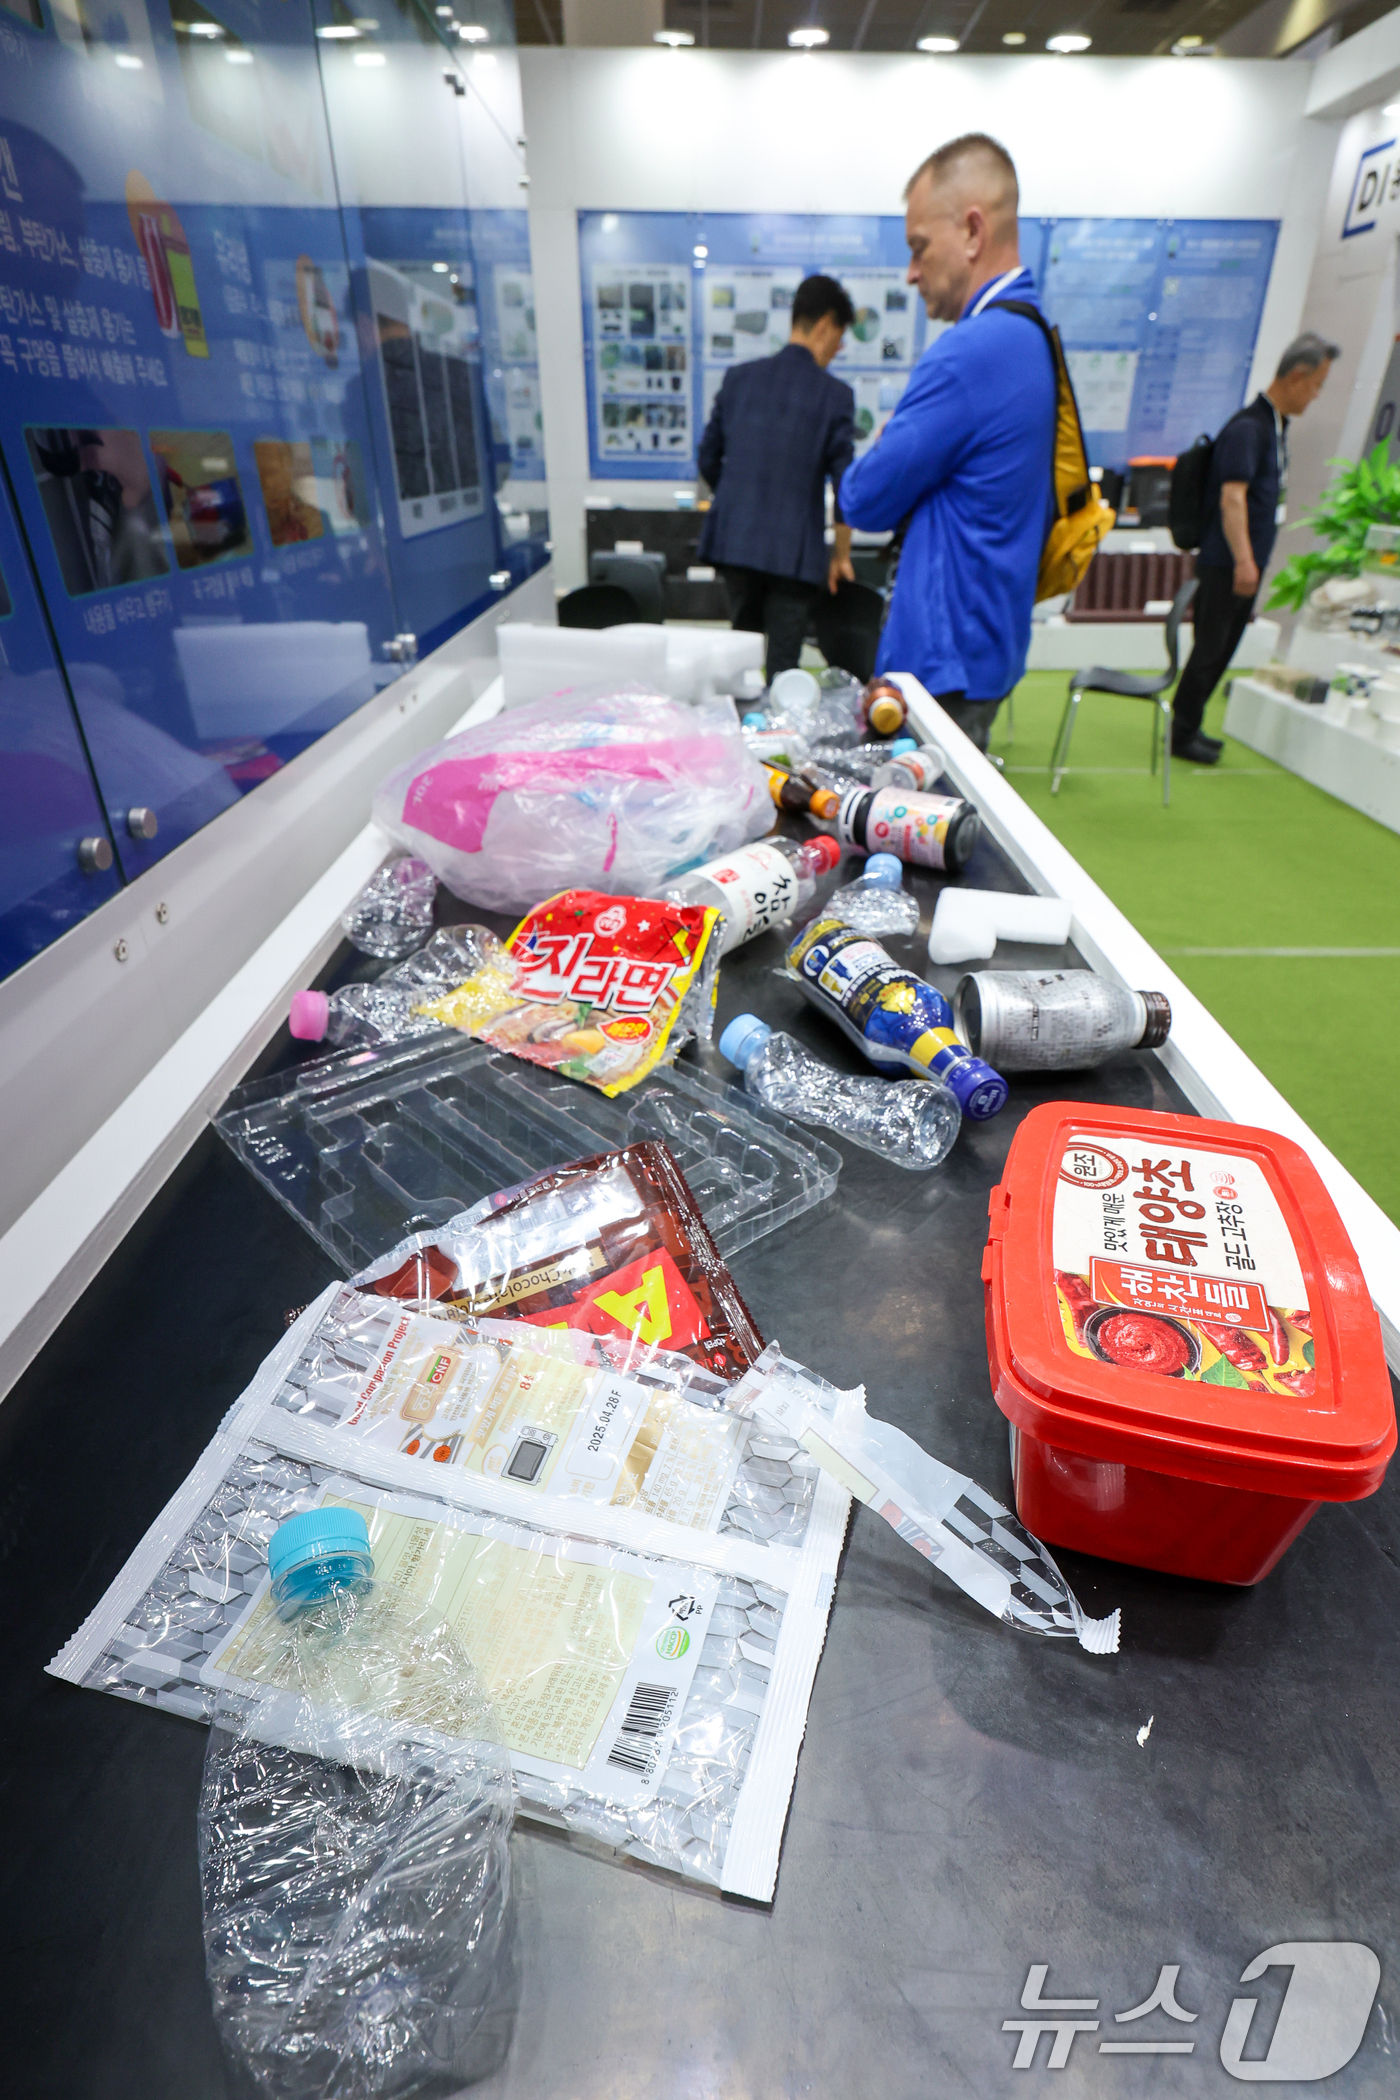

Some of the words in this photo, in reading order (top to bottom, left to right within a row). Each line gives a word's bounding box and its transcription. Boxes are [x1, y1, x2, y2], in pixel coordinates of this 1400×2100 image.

[1074, 1152, 1096, 1178] 원조
[1102, 1192, 1126, 1214] 매운
[1131, 1158, 1208, 1267] 태양초
[1103, 1216, 1128, 1252] 맛있게
[1215, 1201, 1248, 1242] 고추장
[1225, 1242, 1256, 1271] 골드
[1120, 1266, 1251, 1310] 해찬들
[385, 1313, 414, 1351] Project
[473, 1408, 497, 1440] 맛있게
[586, 1393, 620, 1454] 2025.04.28
[614, 1469, 639, 1509] 양정보
[650, 1482, 663, 1498] 140
[590, 1611, 608, 1637] 1399
[664, 1630, 678, 1655] HACCP
[522, 1707, 543, 1736] 제품은
[660, 1690, 679, 1728] 205112
[530, 1719, 552, 1749] 기준에
[554, 1714, 580, 1754] 생산공정
[565, 1728, 587, 1758] 컴퓨터
[579, 1697, 601, 1732] 계량으로
